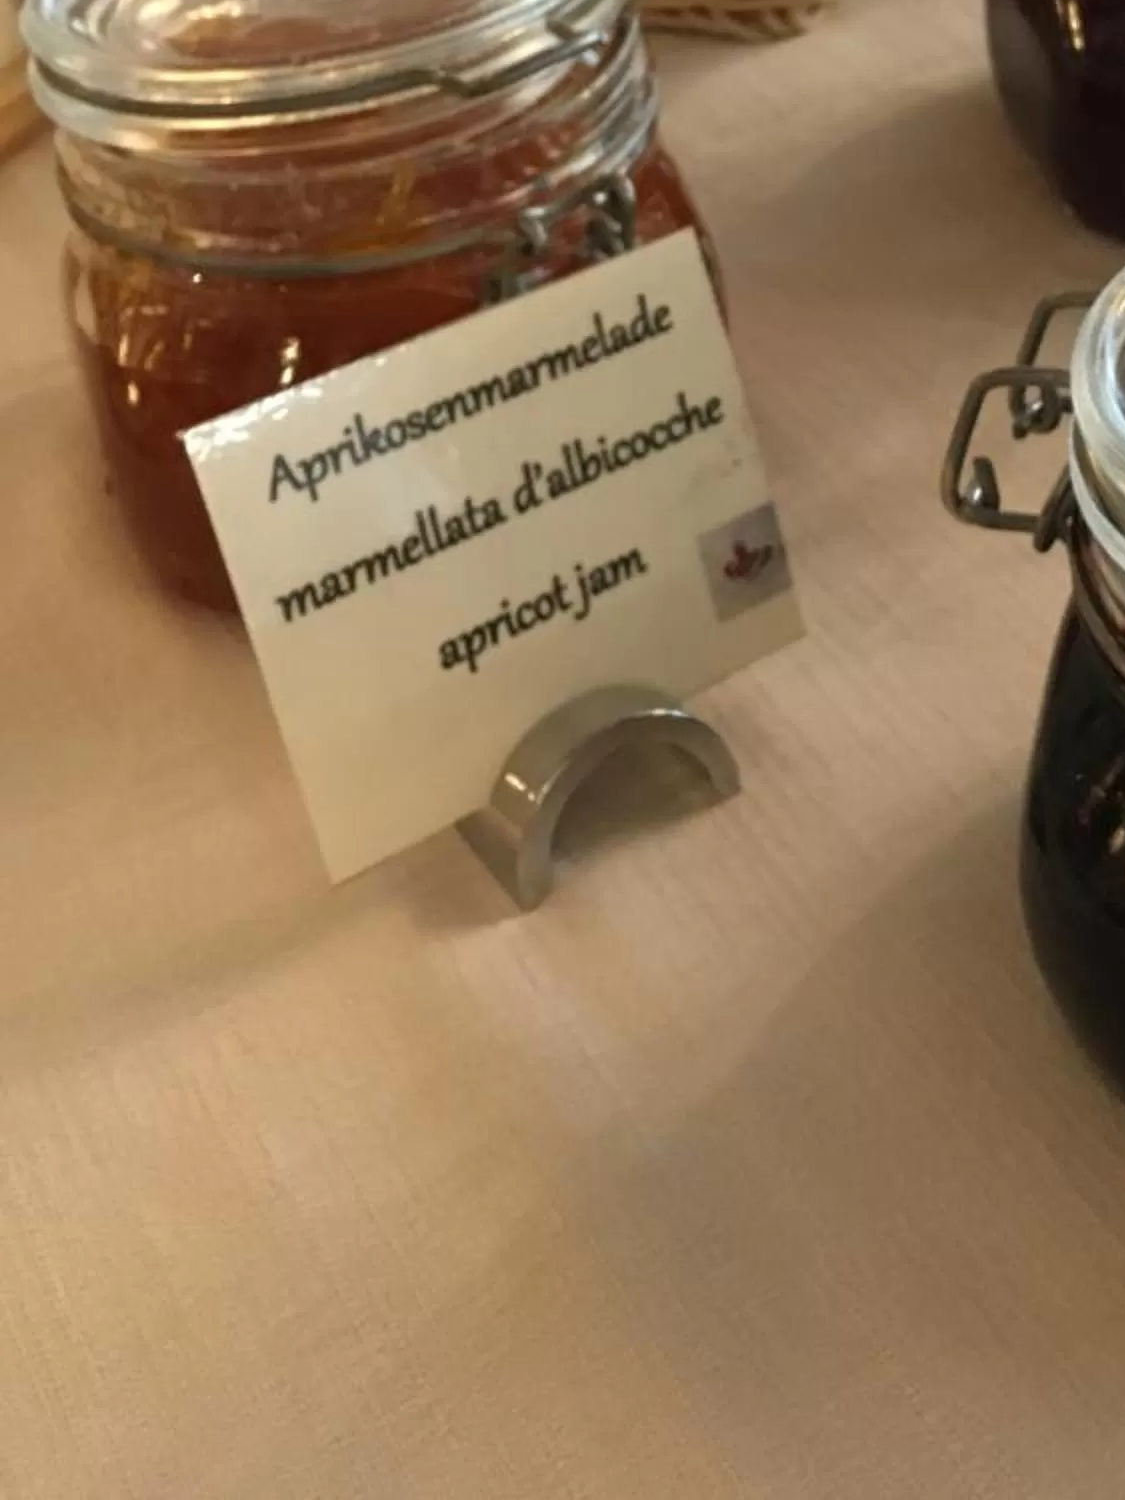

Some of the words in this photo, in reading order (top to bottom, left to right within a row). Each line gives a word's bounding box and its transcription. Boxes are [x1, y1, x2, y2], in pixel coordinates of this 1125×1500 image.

[267, 294, 674, 502] Aprikosenmarmelade
[276, 497, 506, 622] marmellata
[512, 391, 724, 515] d'albicocche
[438, 574, 575, 672] apricot
[572, 544, 648, 621] jam
